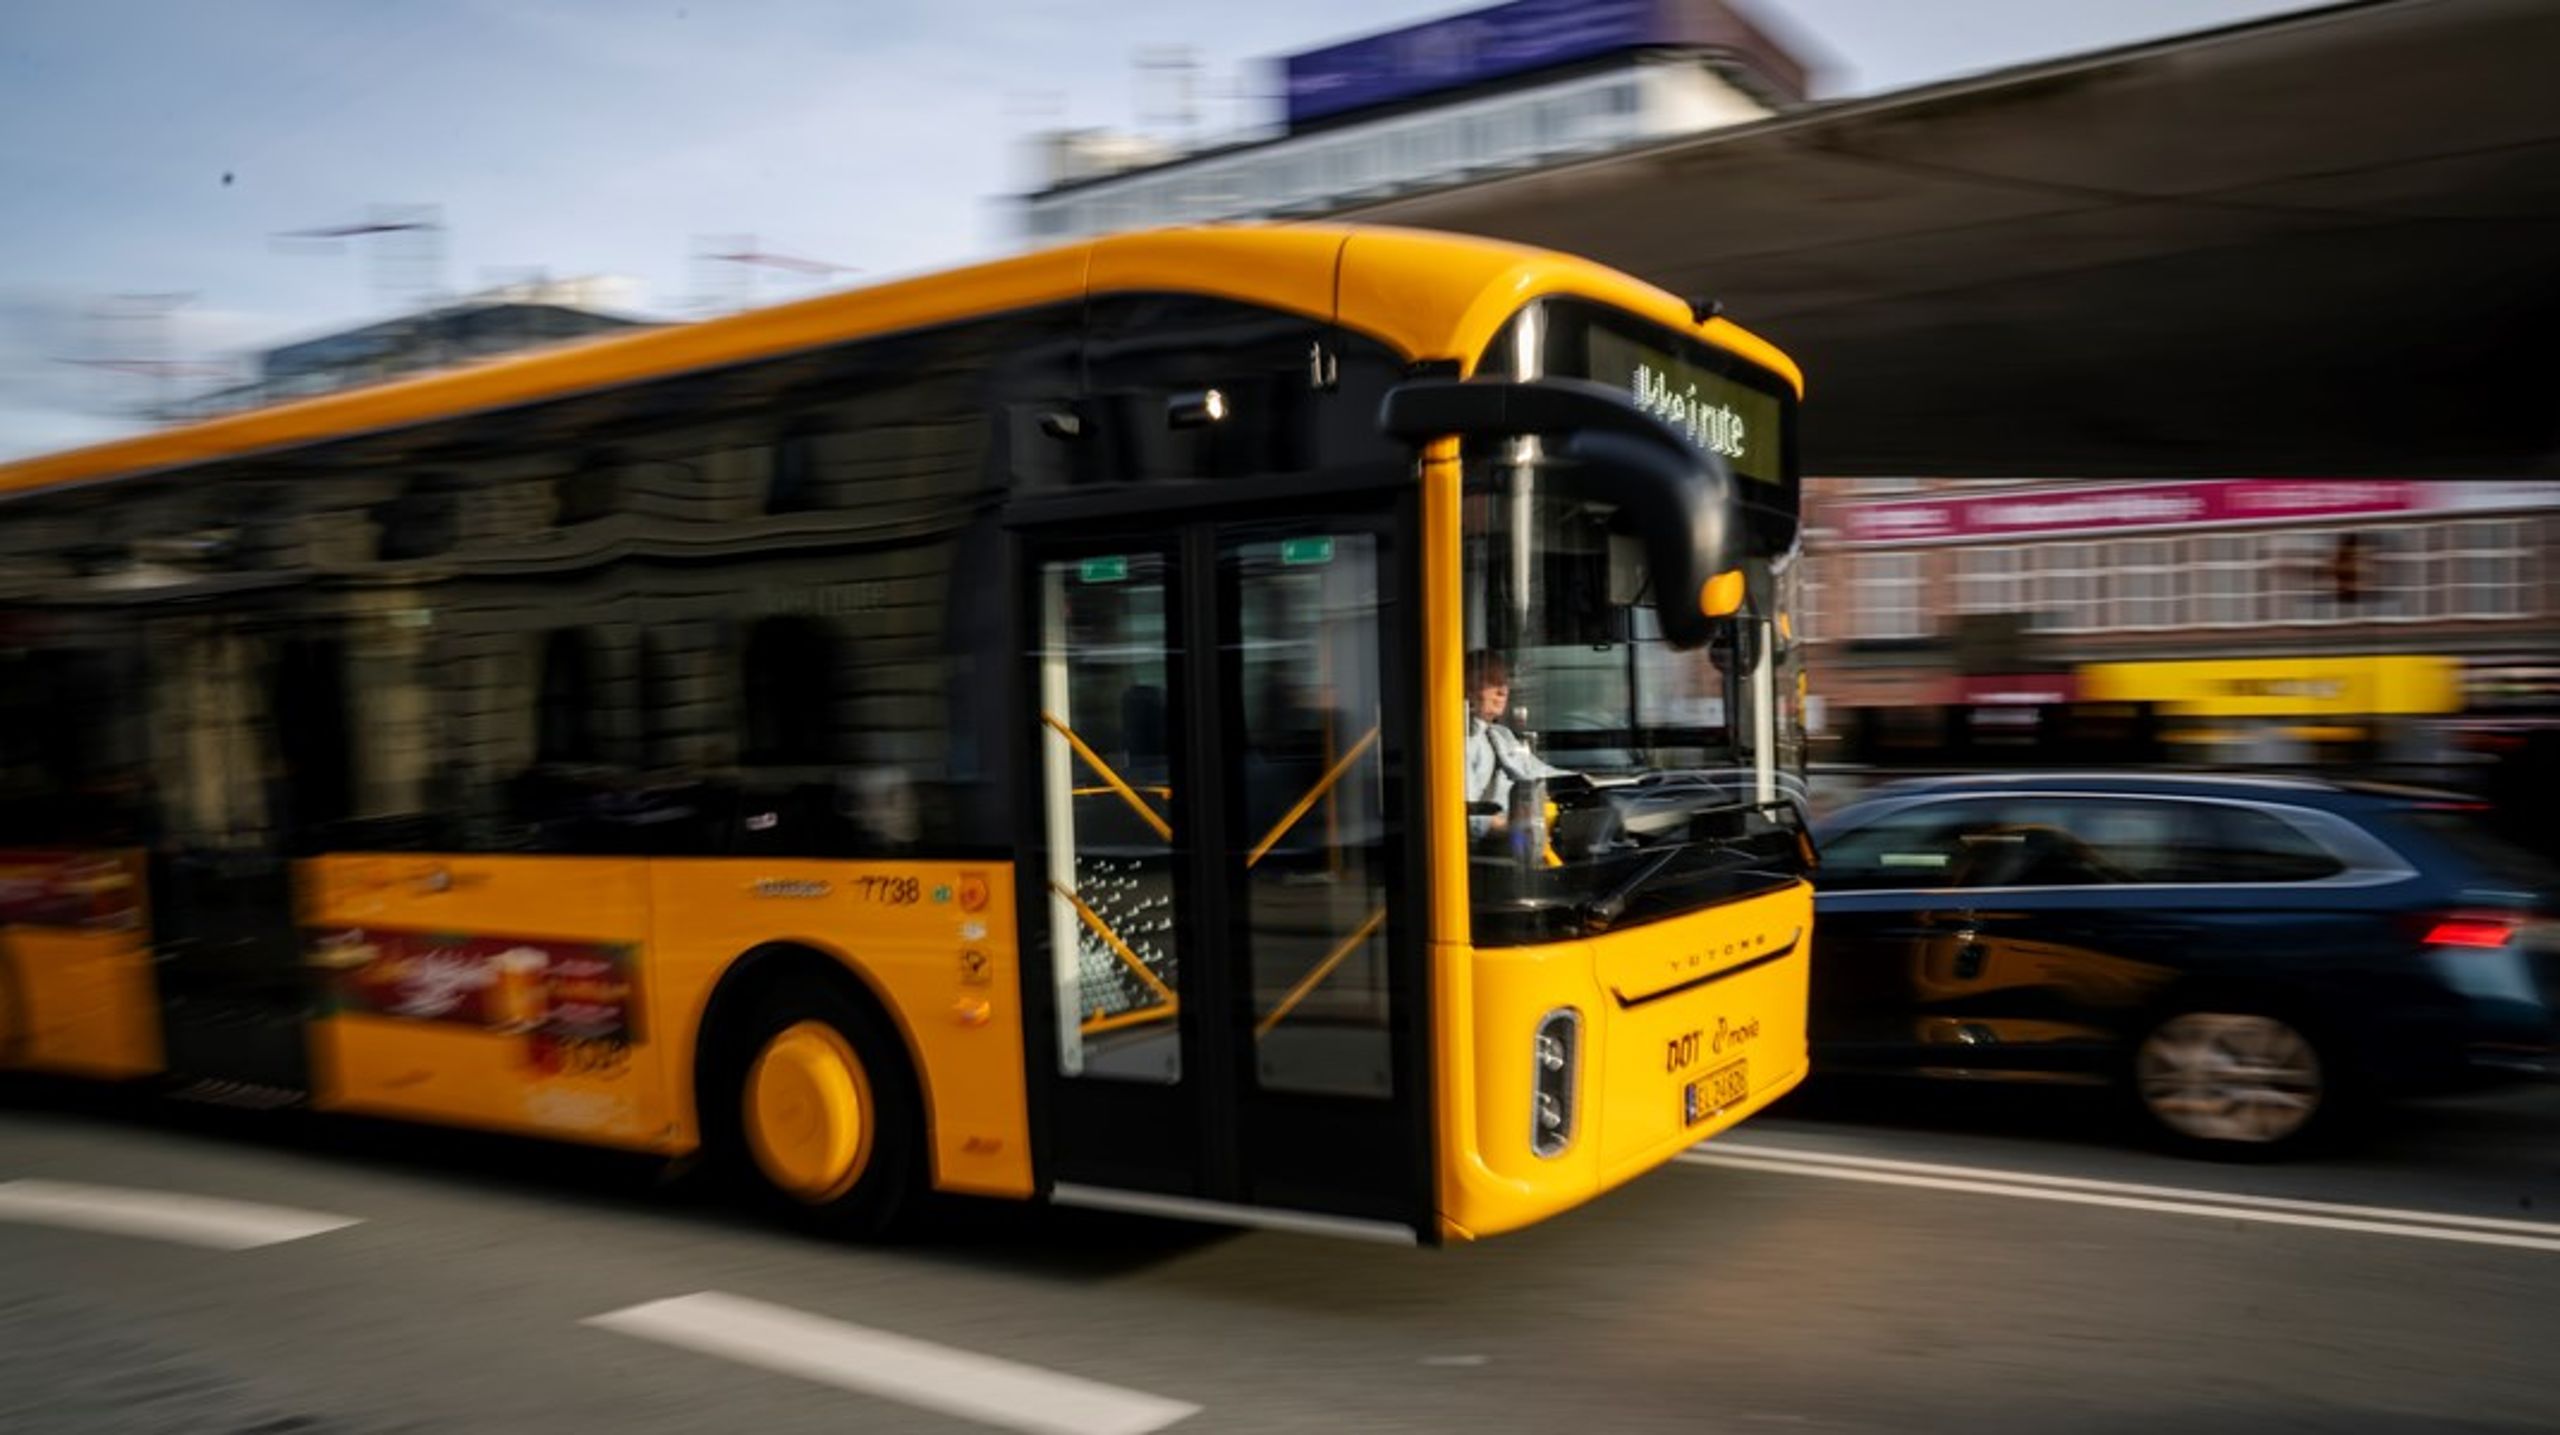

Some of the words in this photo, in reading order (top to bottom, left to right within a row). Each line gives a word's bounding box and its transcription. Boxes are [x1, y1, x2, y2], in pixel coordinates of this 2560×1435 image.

[1698, 402, 1746, 458] rute
[856, 875, 921, 906] 7738
[1667, 1031, 1702, 1073] DOT
